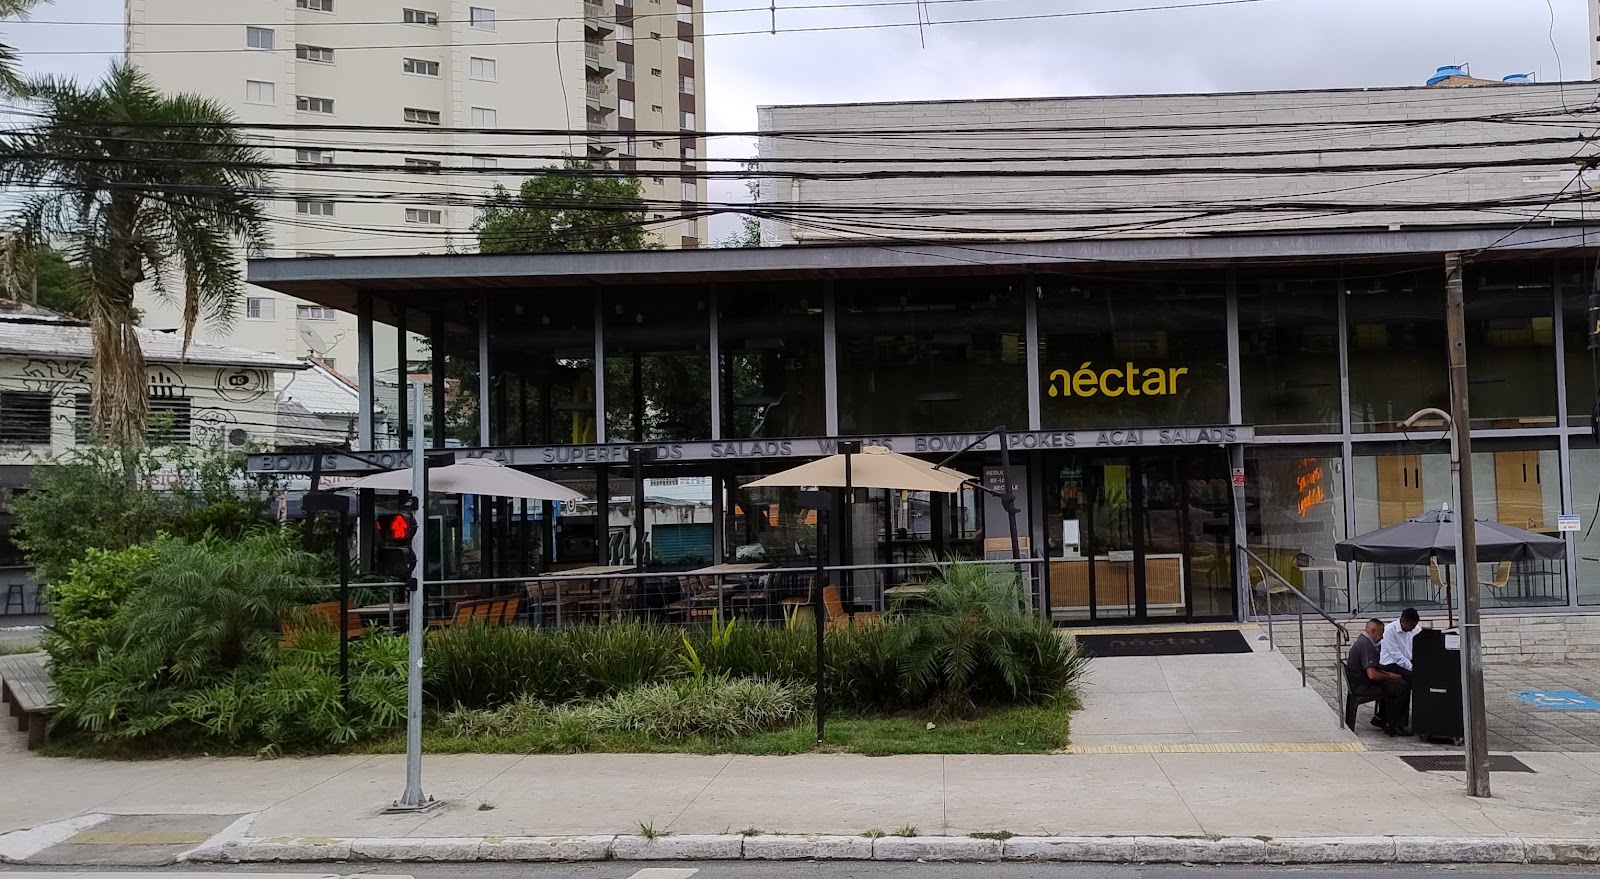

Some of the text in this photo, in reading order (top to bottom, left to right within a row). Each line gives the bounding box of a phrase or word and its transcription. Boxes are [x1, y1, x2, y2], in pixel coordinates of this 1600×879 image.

[1048, 361, 1189, 397] néctar
[263, 456, 337, 470] BOWS
[543, 444, 683, 462] SUPERFDS
[711, 441, 792, 458] SALADS
[1009, 431, 1076, 448] POKES
[1096, 430, 1143, 446] ACAI
[1159, 428, 1237, 444] SALADS
